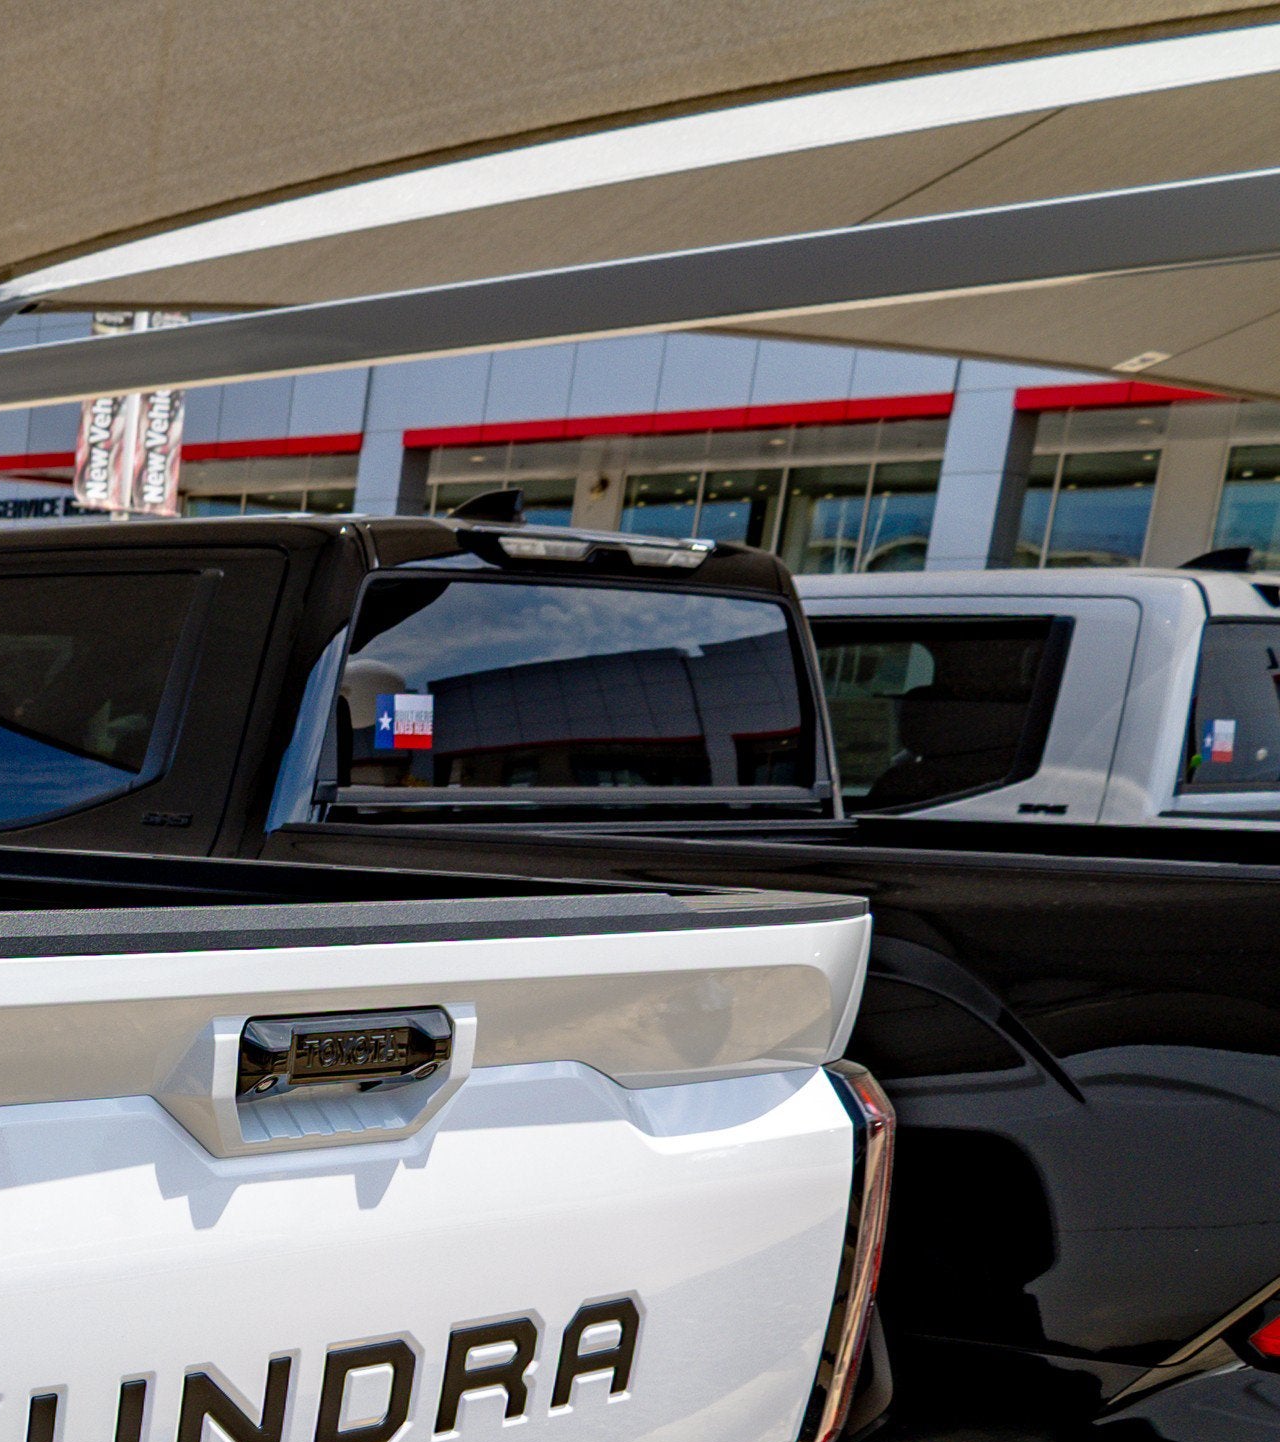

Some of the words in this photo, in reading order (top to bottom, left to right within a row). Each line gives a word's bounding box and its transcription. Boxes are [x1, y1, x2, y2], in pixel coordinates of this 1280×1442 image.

[85, 447, 110, 500] New
[143, 451, 167, 504] New
[304, 1034, 400, 1068] TOYOTA
